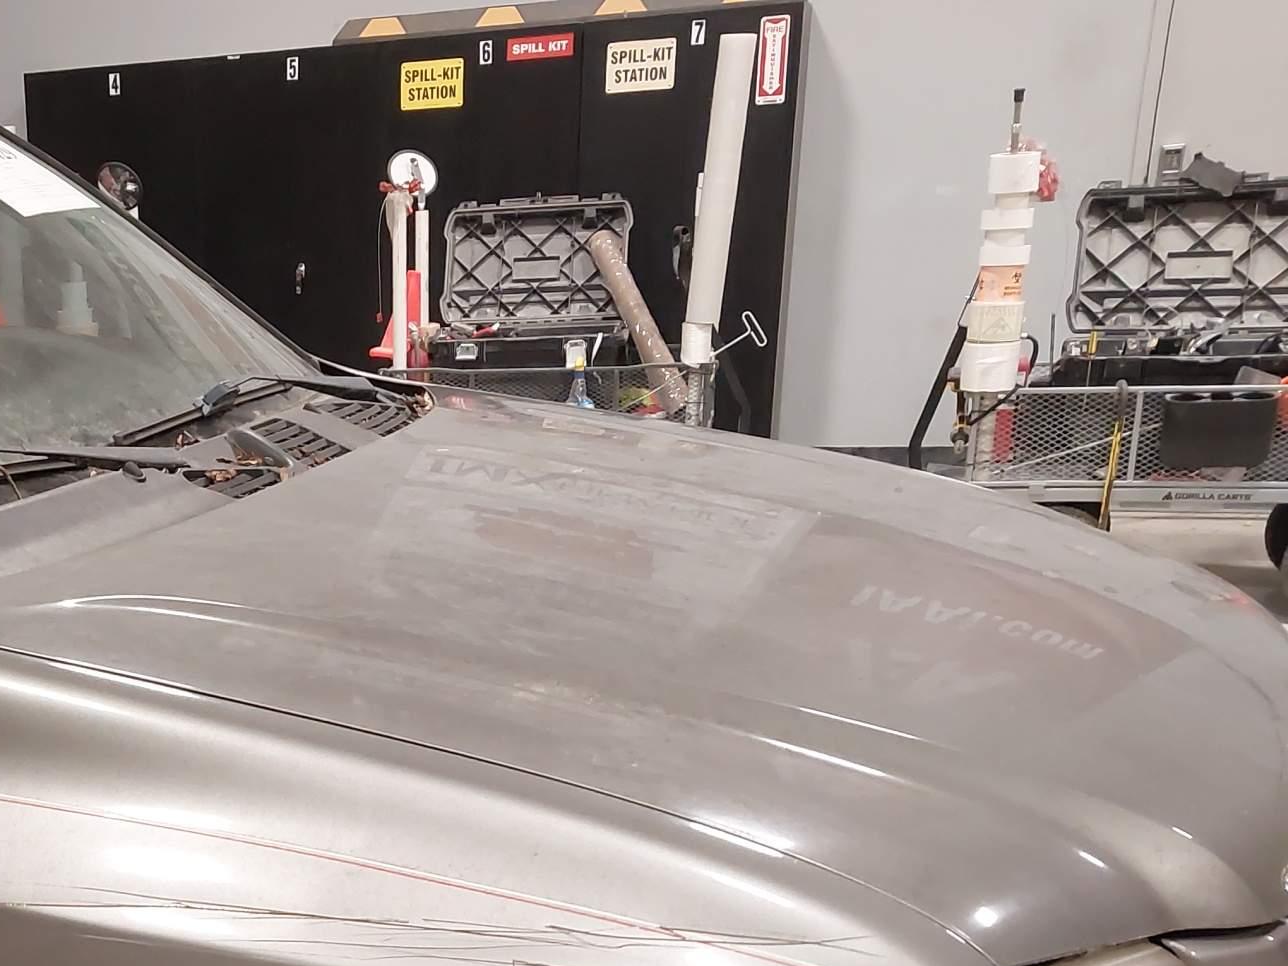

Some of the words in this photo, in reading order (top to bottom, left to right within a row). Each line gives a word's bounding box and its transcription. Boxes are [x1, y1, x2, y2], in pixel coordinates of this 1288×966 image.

[694, 21, 704, 43] 7
[482, 42, 491, 62] 6
[512, 43, 545, 55] SPILL
[549, 40, 569, 52] KIT
[611, 47, 673, 65] SPILL-KIT
[289, 59, 297, 78] 5
[404, 65, 461, 83] SPILL-KIT
[615, 66, 668, 84] STATION
[111, 75, 119, 94] 4
[408, 85, 457, 102] STATION
[1174, 492, 1215, 501] GORILLA
